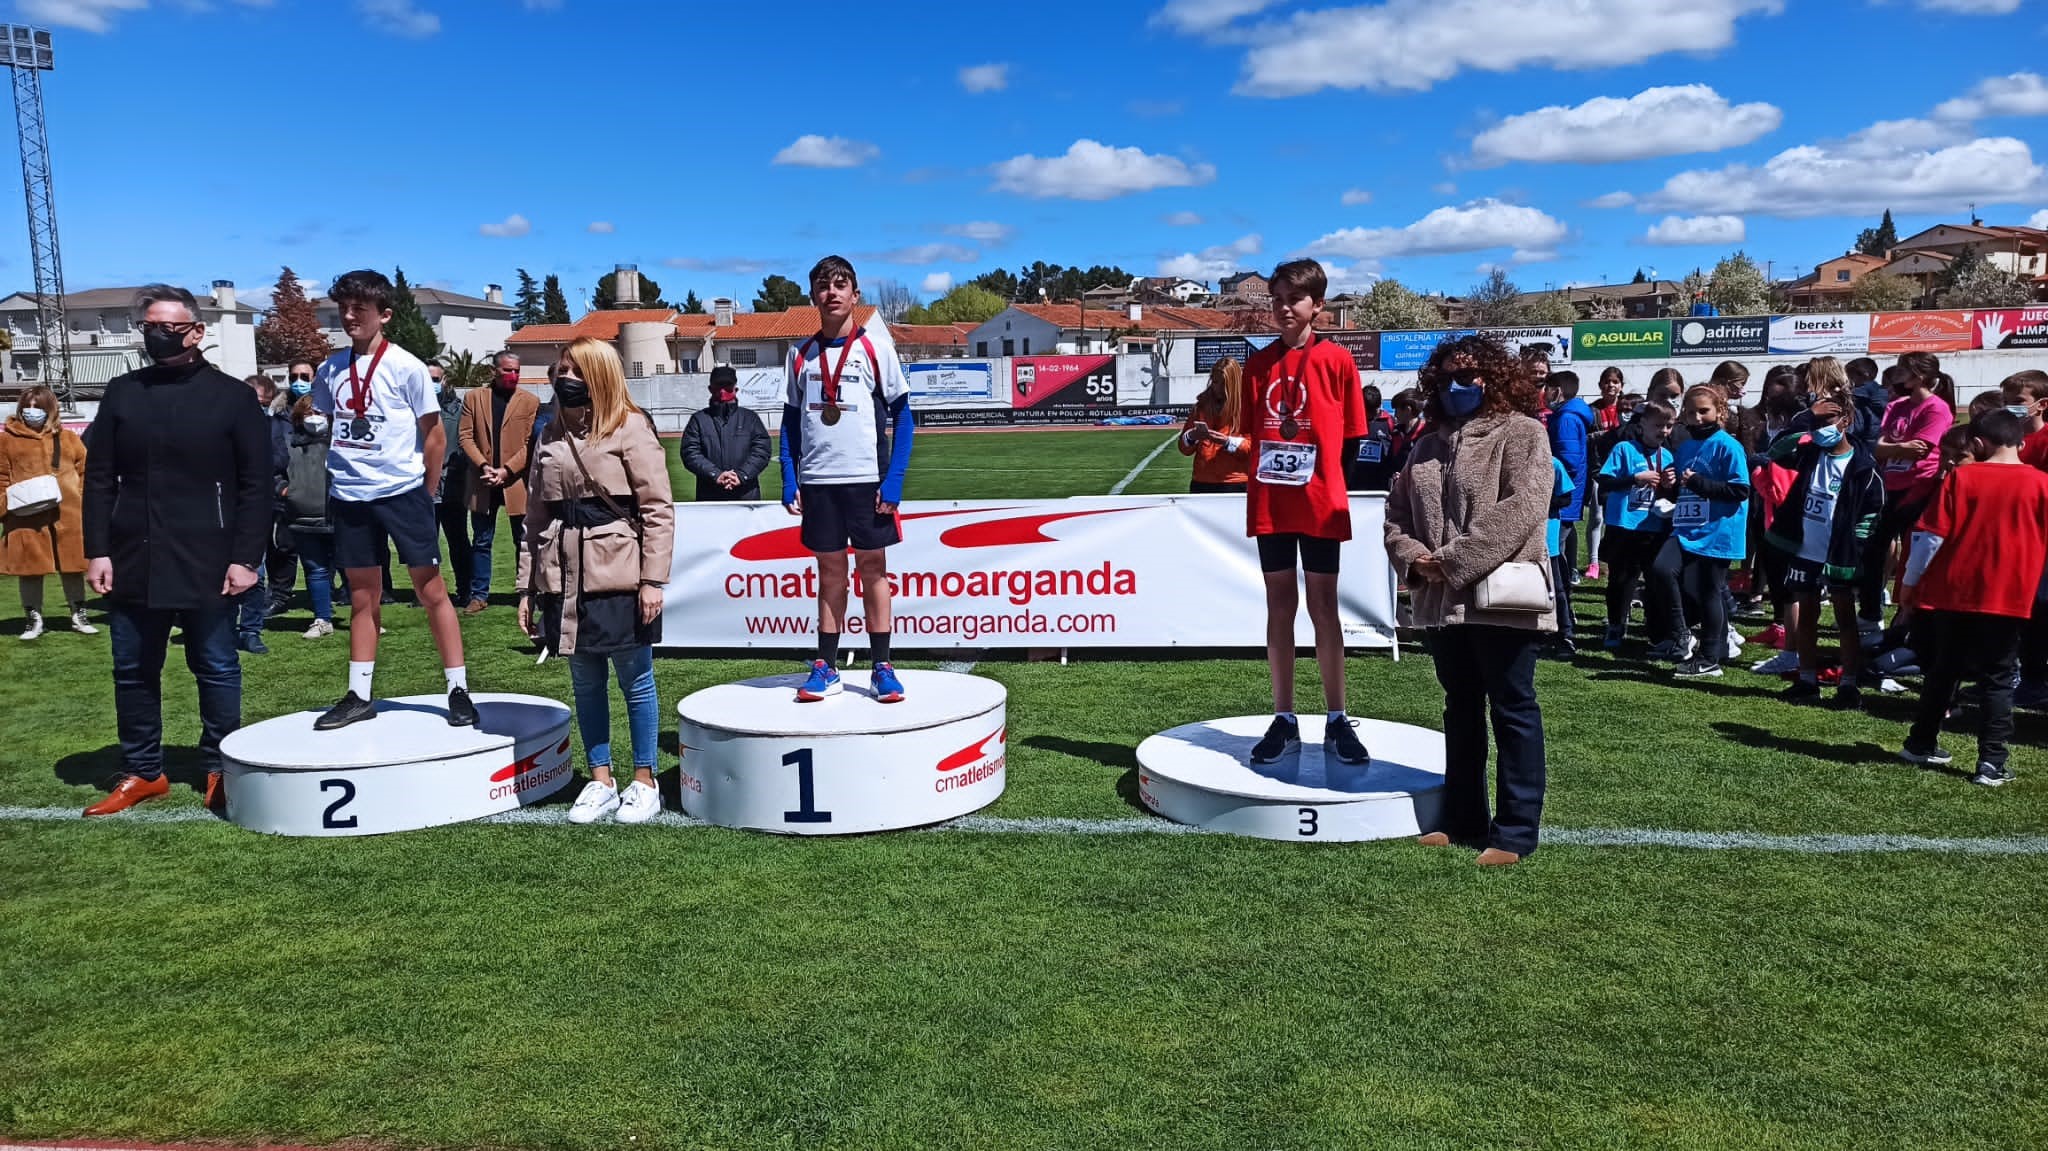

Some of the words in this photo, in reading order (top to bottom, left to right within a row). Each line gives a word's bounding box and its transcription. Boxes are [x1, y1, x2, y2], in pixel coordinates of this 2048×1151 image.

[1706, 325, 1763, 338] adriferr
[1794, 320, 1844, 330] Iberext
[1598, 331, 1663, 342] AGUILAR
[1038, 364, 1080, 372] 14-02-1964
[821, 385, 844, 402] 1
[1085, 374, 1114, 395] 55
[1273, 454, 1299, 473] 53
[725, 561, 1137, 605] cmattsmoarganda
[782, 748, 832, 822] 1
[320, 778, 358, 829] 2
[1298, 807, 1318, 836] 3
